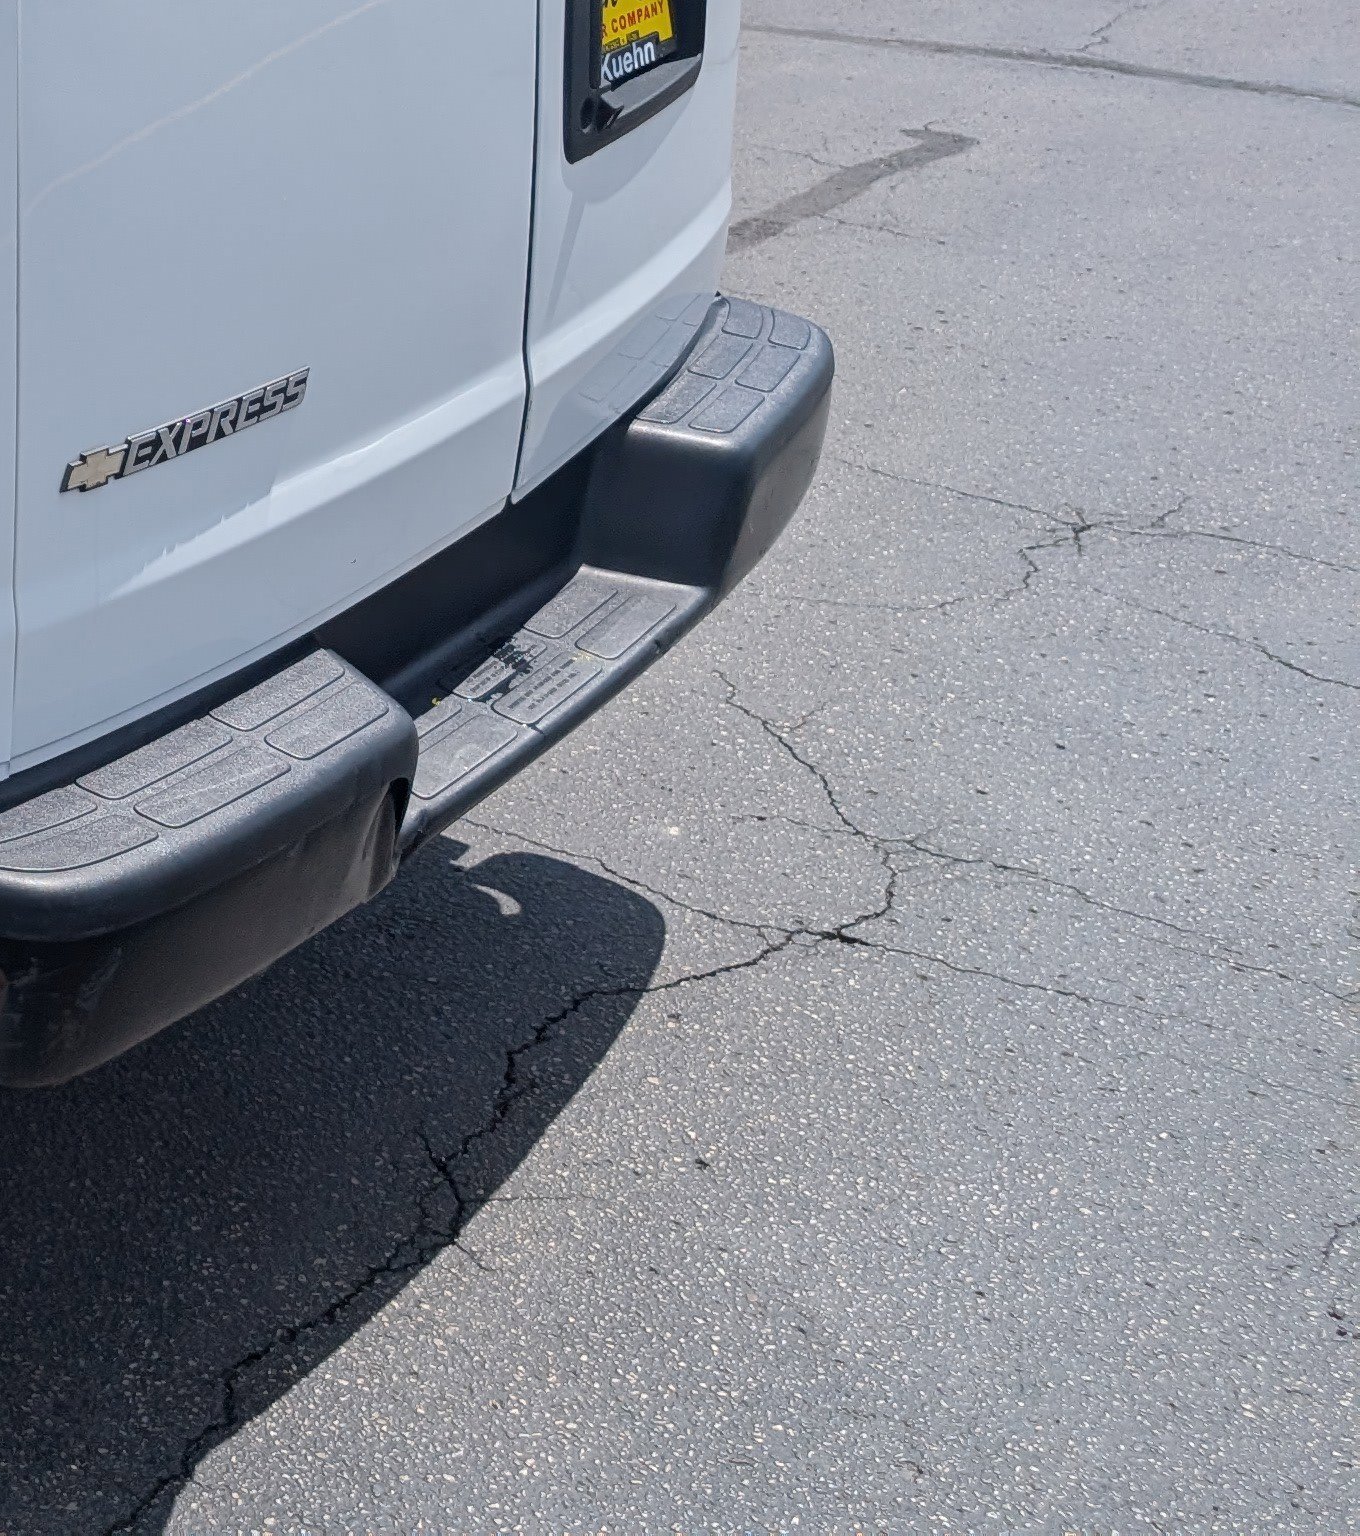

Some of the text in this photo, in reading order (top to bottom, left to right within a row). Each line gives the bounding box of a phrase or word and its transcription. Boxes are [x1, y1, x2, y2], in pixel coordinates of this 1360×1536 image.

[611, 0, 664, 33] COMPANY
[600, 41, 656, 81] Kuehn
[123, 370, 309, 477] EXPRESS
